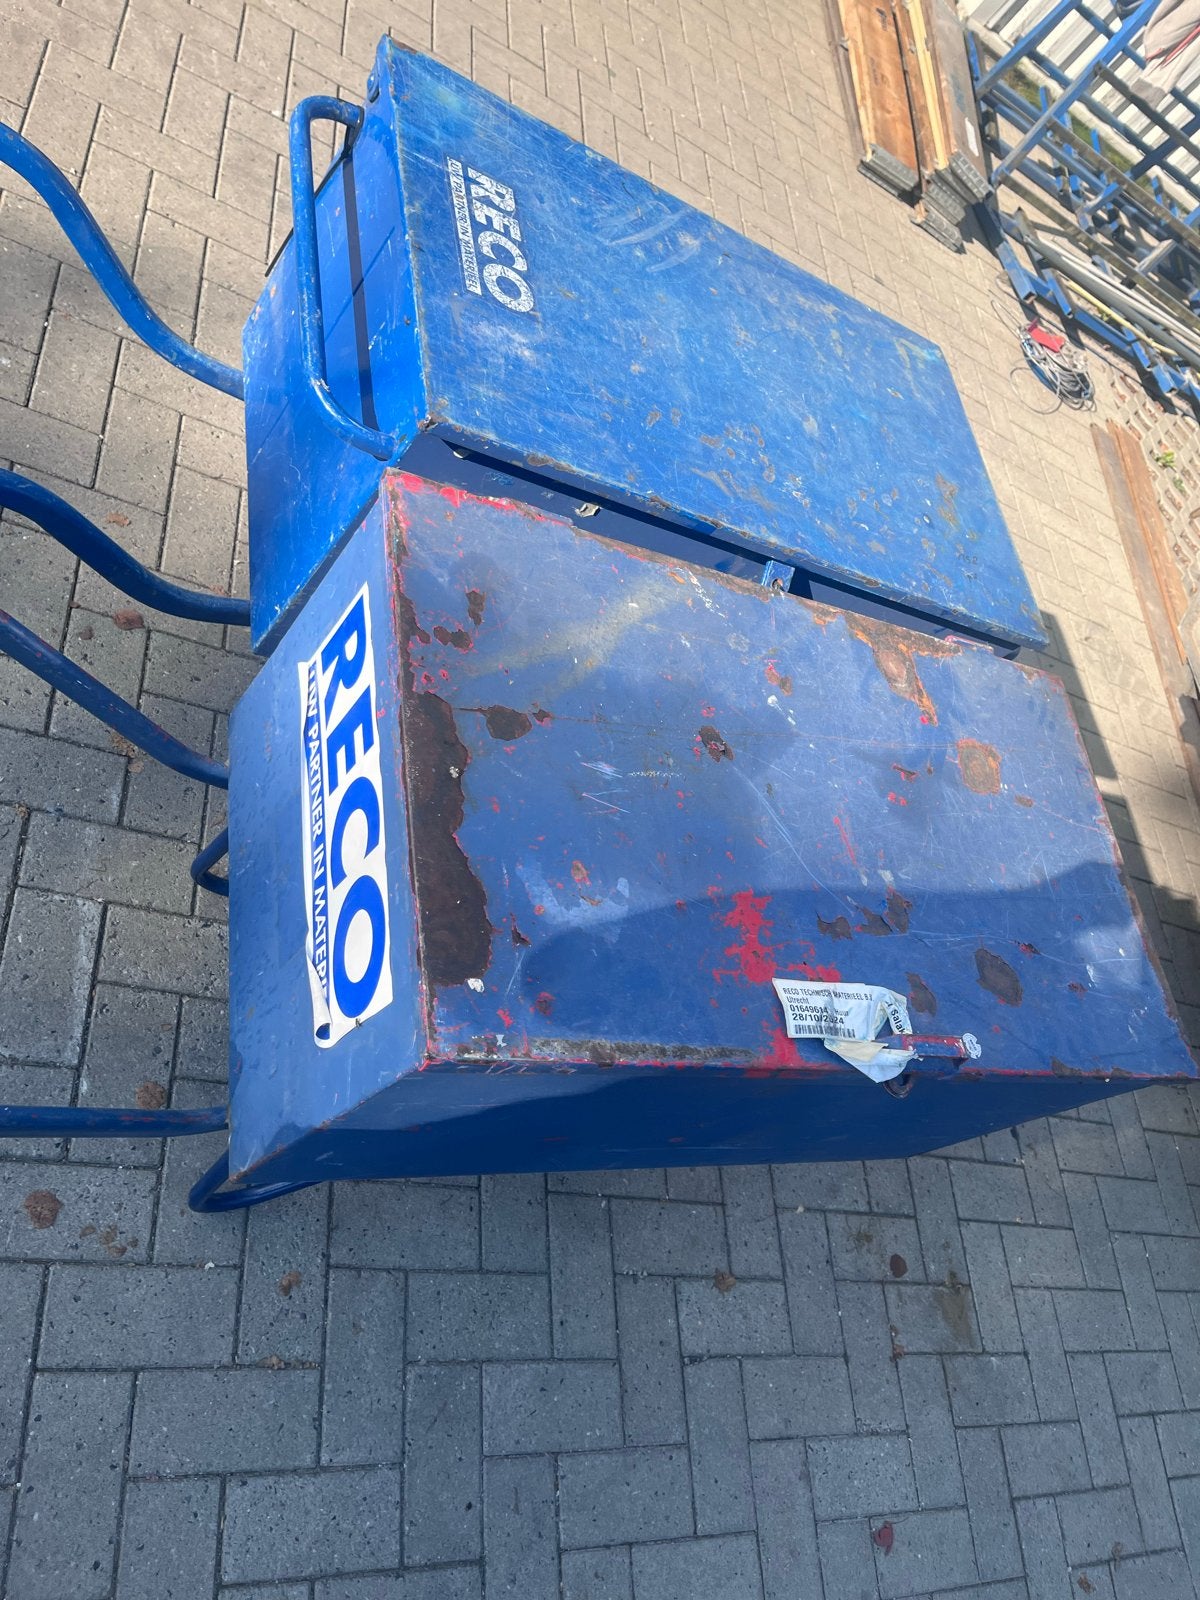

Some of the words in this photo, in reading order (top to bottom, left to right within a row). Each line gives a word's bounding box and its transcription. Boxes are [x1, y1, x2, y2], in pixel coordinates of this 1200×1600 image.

[453, 181, 467, 225] PARTNER
[460, 225, 469, 238] IN
[467, 167, 534, 313] RECO
[462, 239, 478, 290] MATERIEEL
[309, 722, 325, 838] PARTNER
[320, 600, 386, 1018] RECO
[313, 843, 327, 880] IN
[782, 987, 800, 996] RECO
[799, 988, 832, 998] TECHNISCH
[832, 991, 864, 1001] MATERIEEL
[786, 996, 810, 1004] Utrecht
